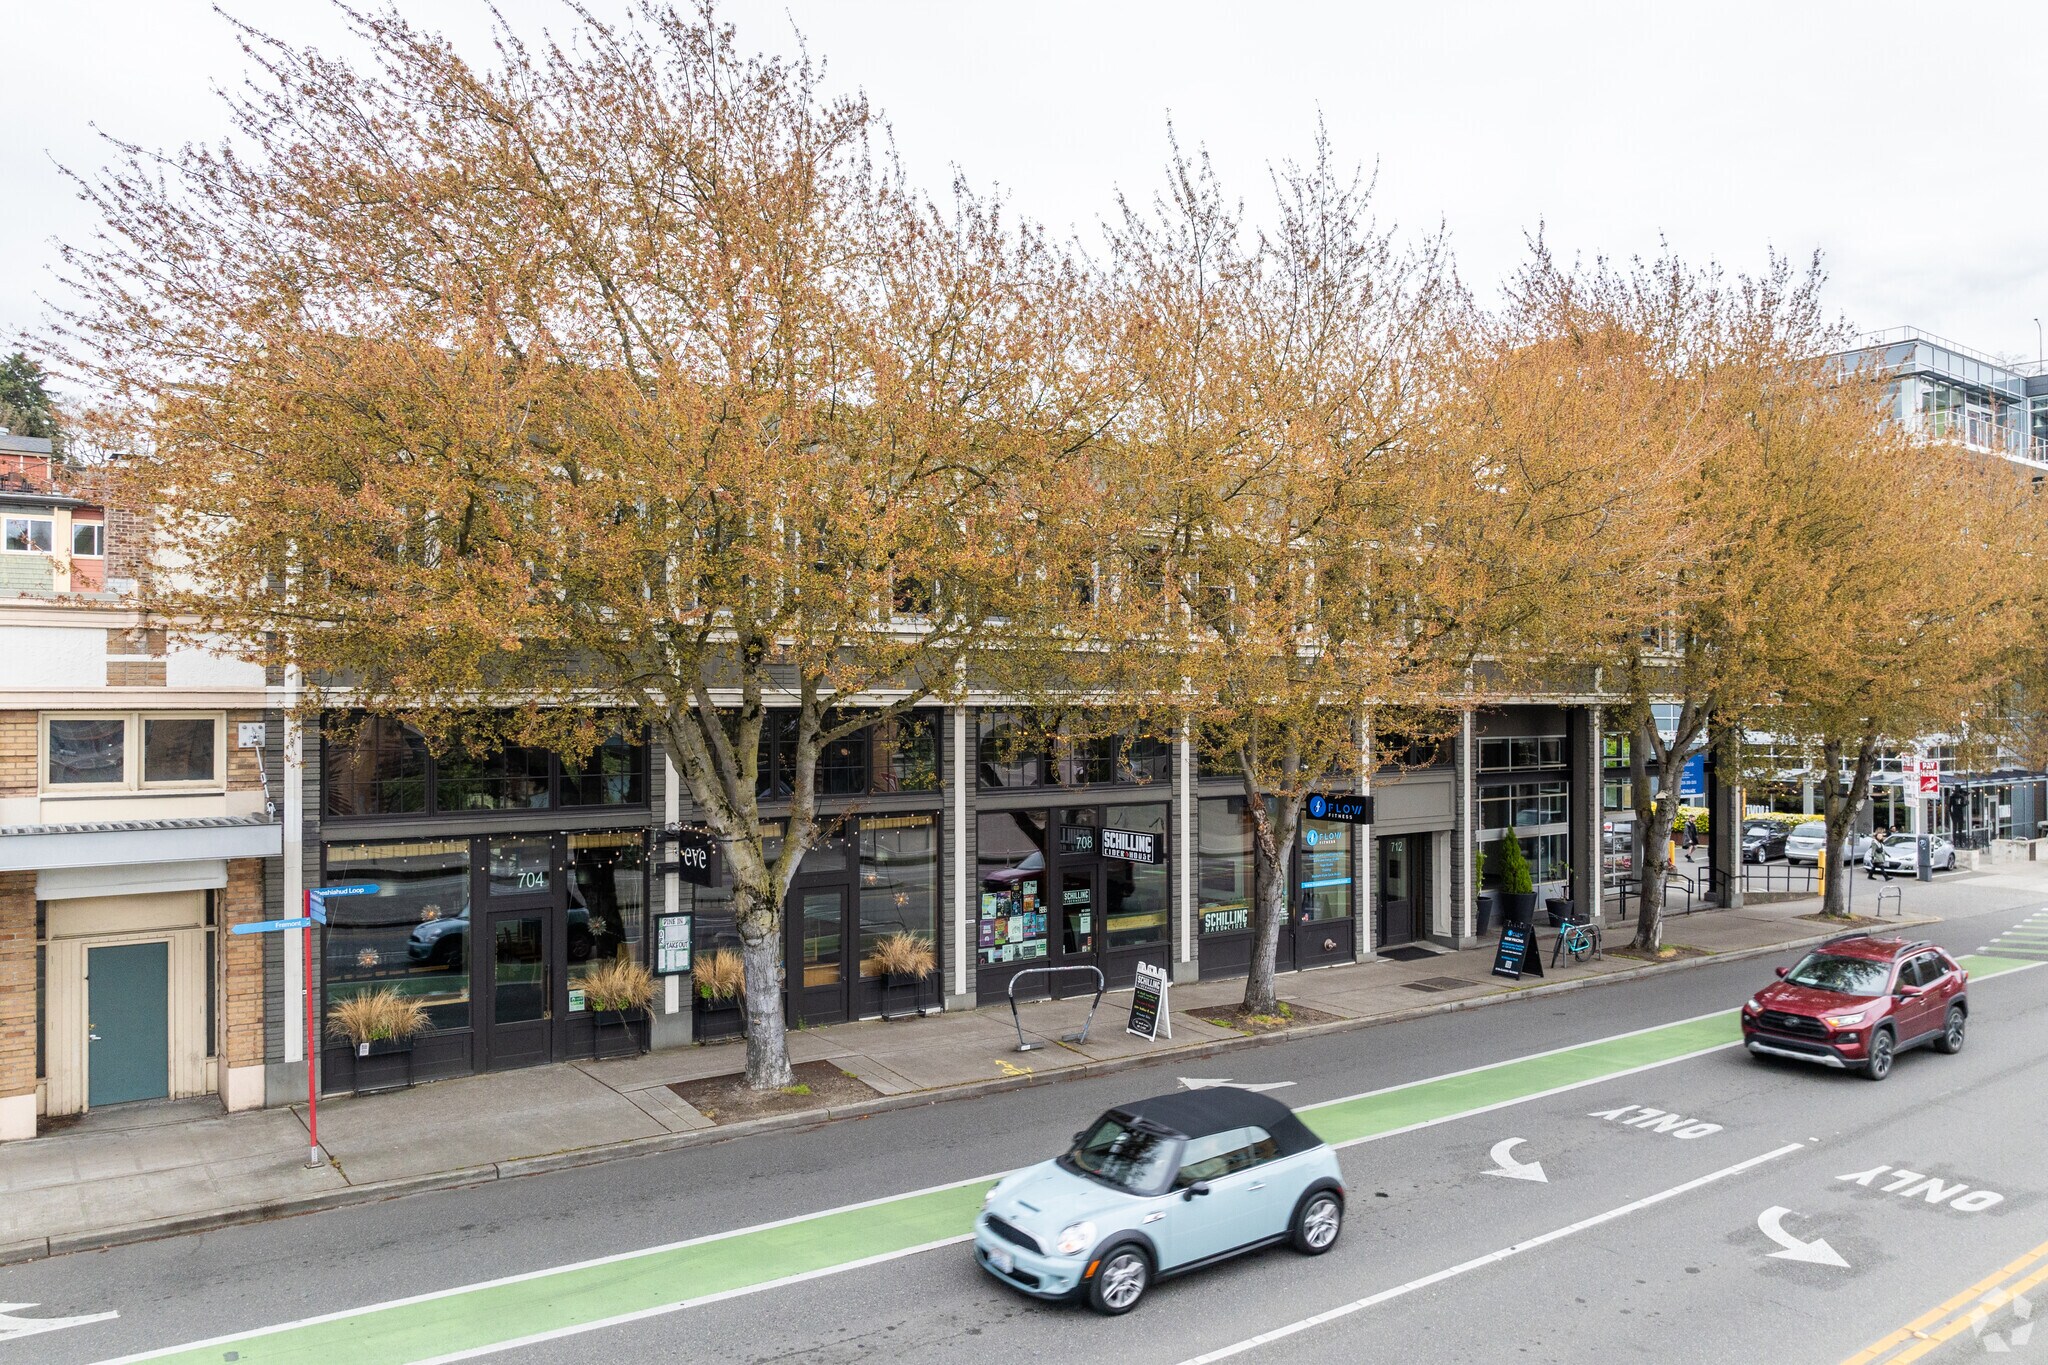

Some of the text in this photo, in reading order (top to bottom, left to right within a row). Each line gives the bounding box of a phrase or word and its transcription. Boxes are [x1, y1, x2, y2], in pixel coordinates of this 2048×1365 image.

[1922, 761, 1935, 769] PAY
[1920, 769, 1937, 777] HERE
[1328, 803, 1362, 815] FLOW
[1104, 831, 1152, 853] SCHILLING
[1319, 831, 1342, 840] FLOW
[1076, 836, 1093, 850] 708
[1390, 841, 1403, 852] 712
[684, 847, 707, 869] eve
[1104, 848, 1152, 861] CIDER HOUSE
[517, 871, 544, 889] 704
[1205, 909, 1248, 927] SCHILLING
[1588, 1104, 1723, 1140] ONLY
[1834, 1164, 2004, 1212] ONLY
